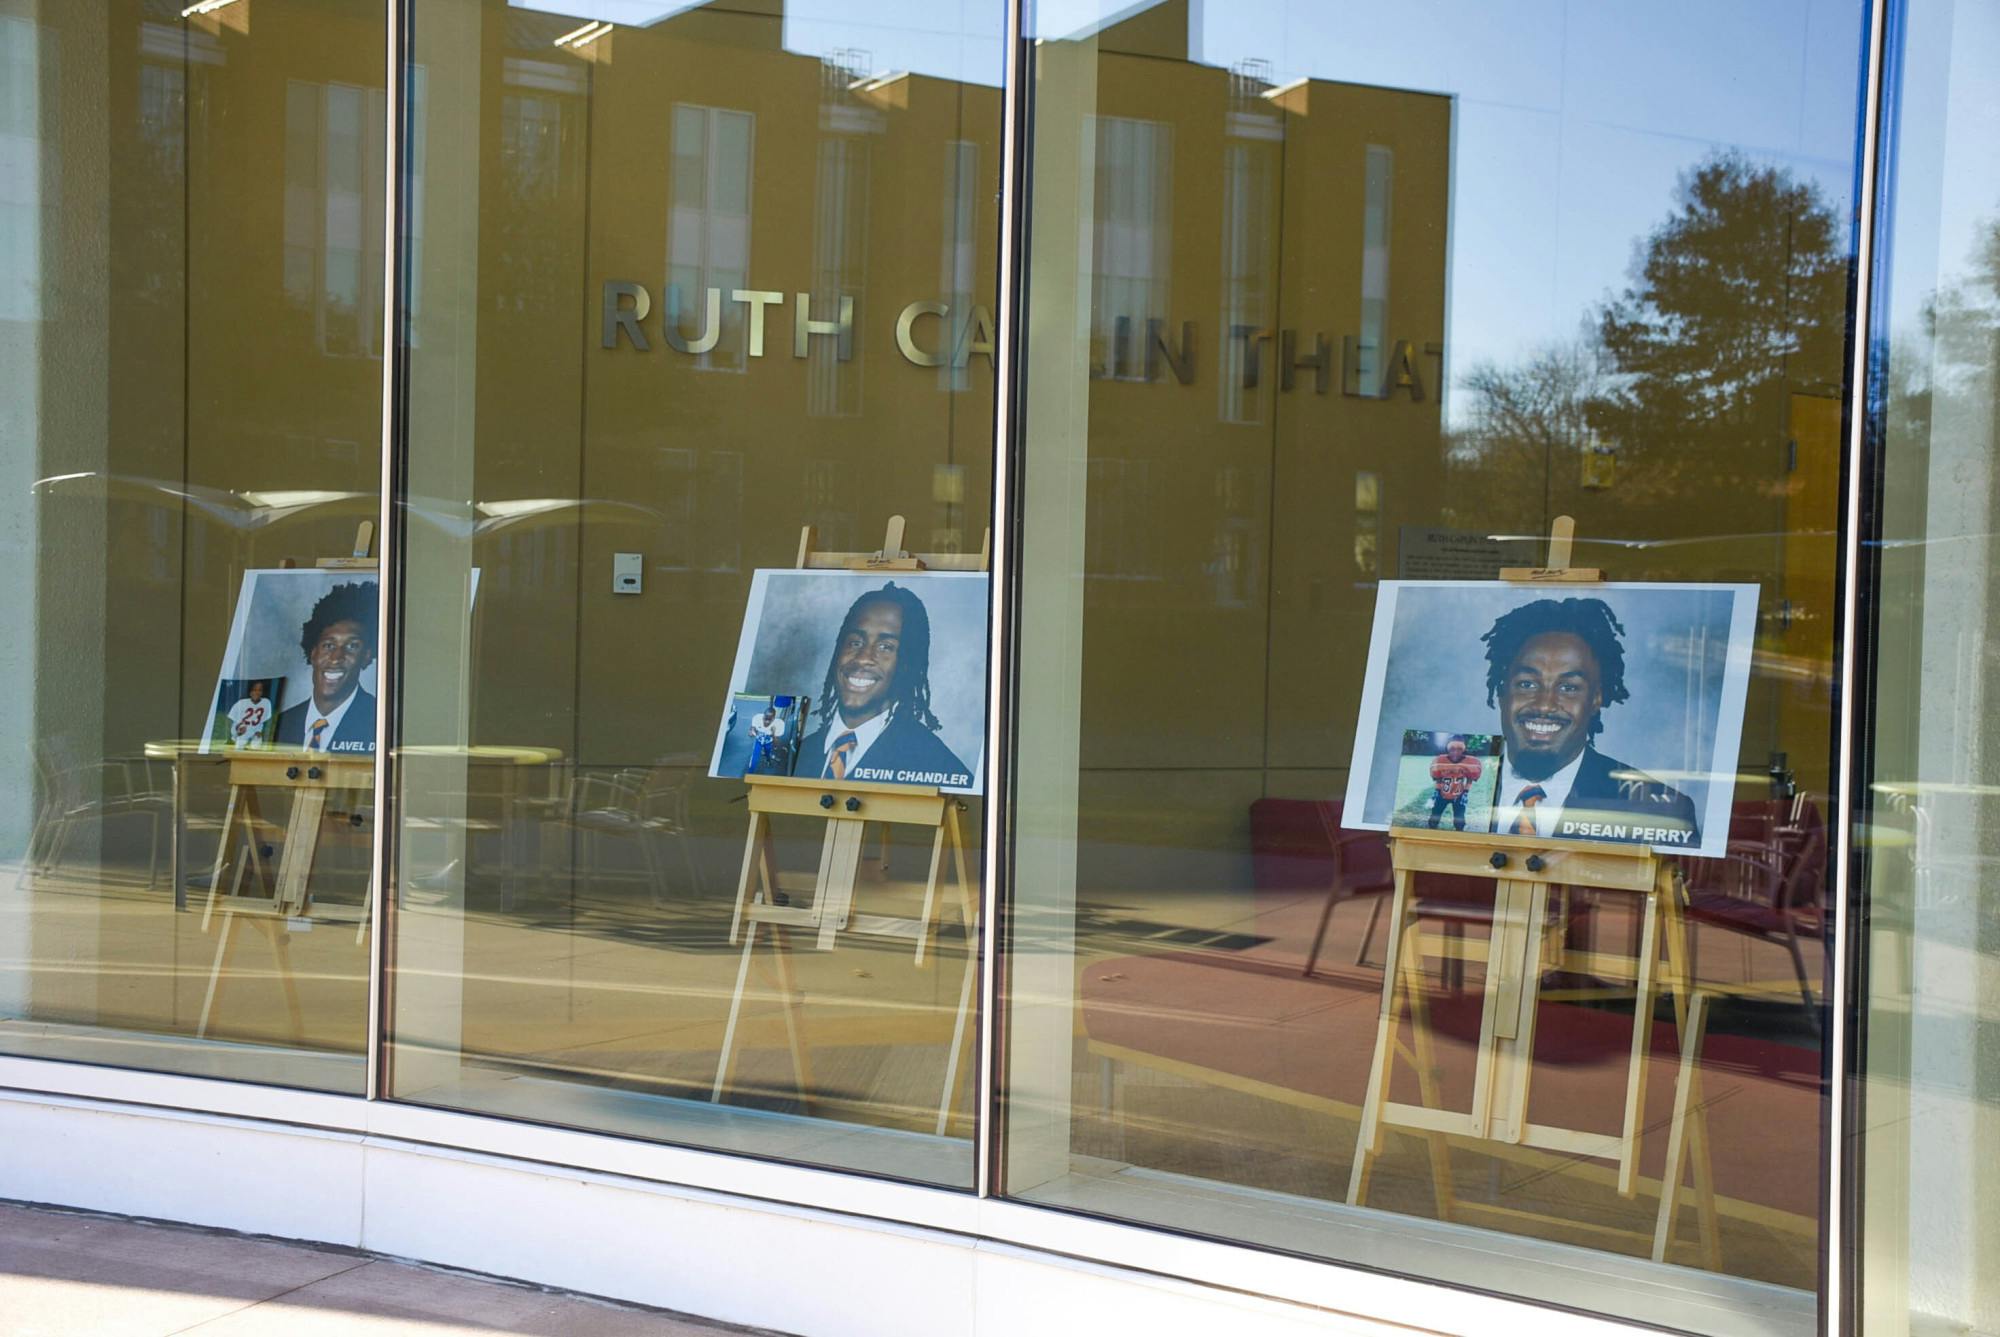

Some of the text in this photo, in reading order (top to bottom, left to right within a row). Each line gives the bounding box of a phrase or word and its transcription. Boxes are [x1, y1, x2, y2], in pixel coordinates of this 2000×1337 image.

[602, 281, 854, 360] RUTH
[242, 707, 264, 726] 23
[332, 741, 365, 752] LAVEL
[854, 767, 969, 789] DEVIN CHANDLER
[1562, 822, 1694, 846] D'SEAN PERRY
